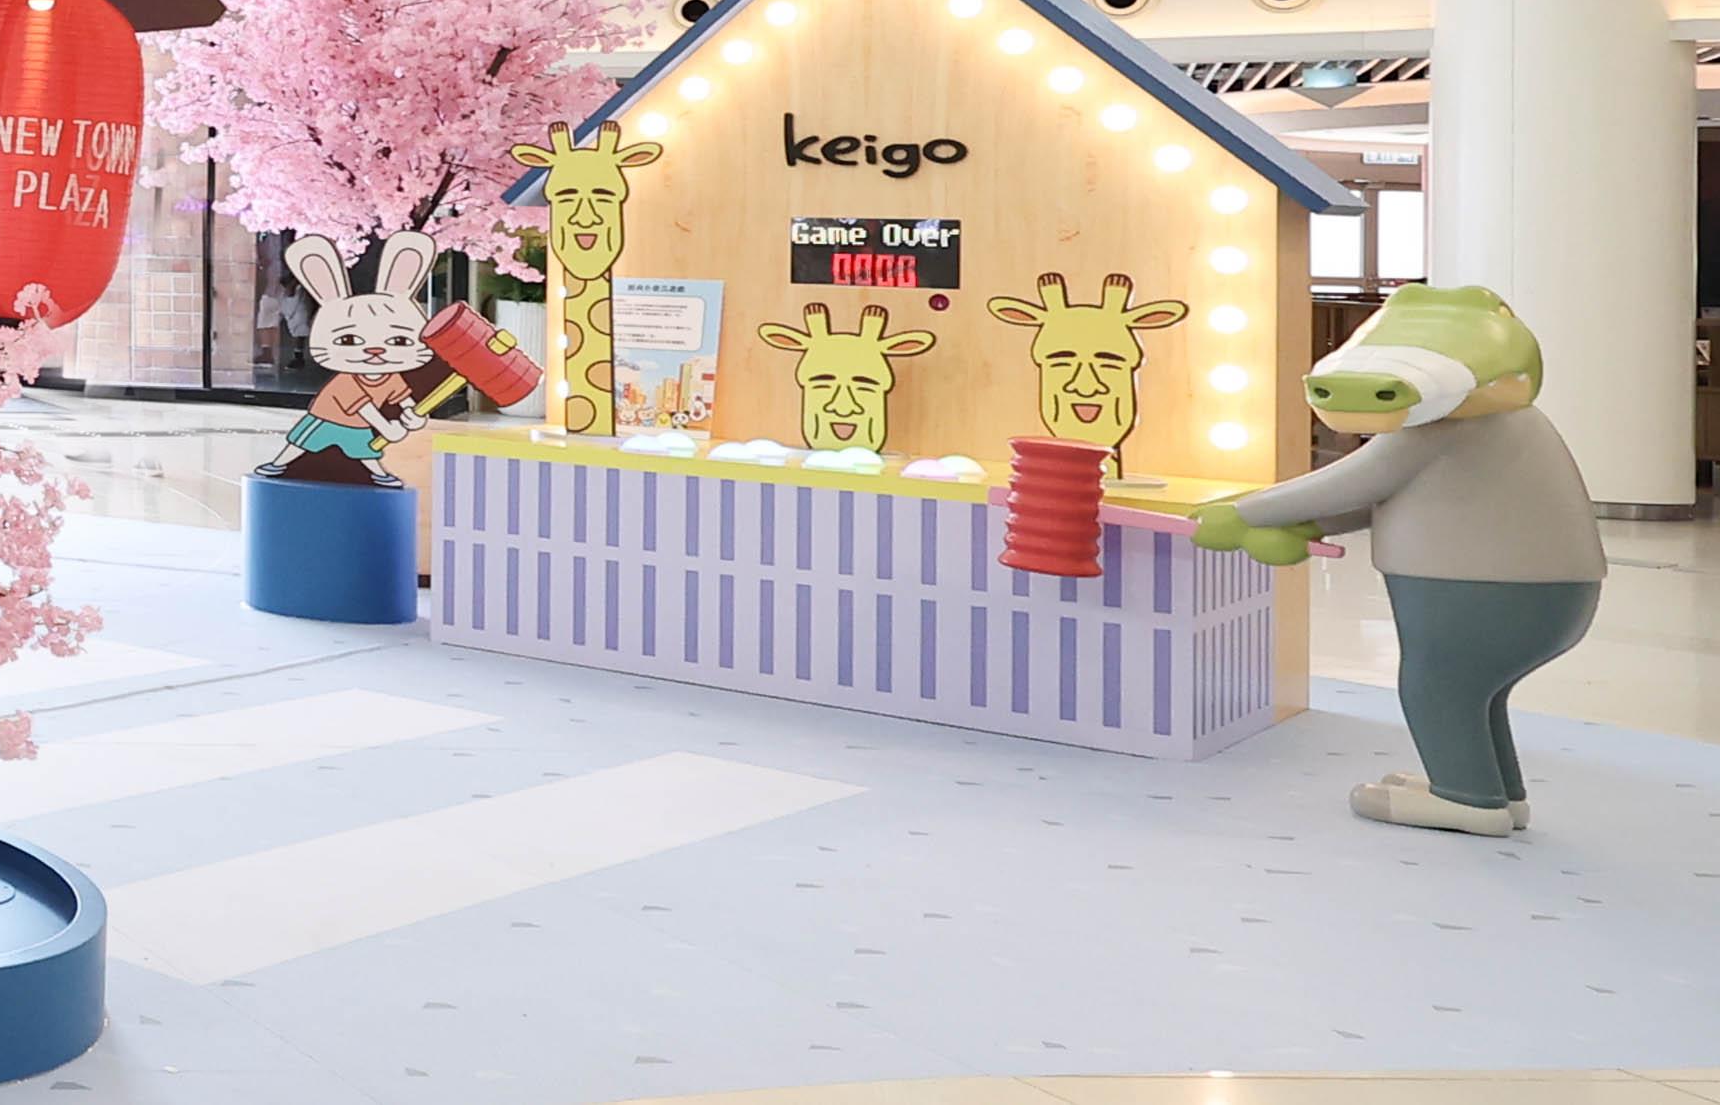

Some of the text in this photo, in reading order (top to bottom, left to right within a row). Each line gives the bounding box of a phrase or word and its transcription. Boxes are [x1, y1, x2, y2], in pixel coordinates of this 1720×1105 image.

[73, 120, 137, 175] TOWN
[784, 112, 968, 179] keigo
[14, 170, 109, 229] PLAZA
[791, 222, 960, 248] Game Over
